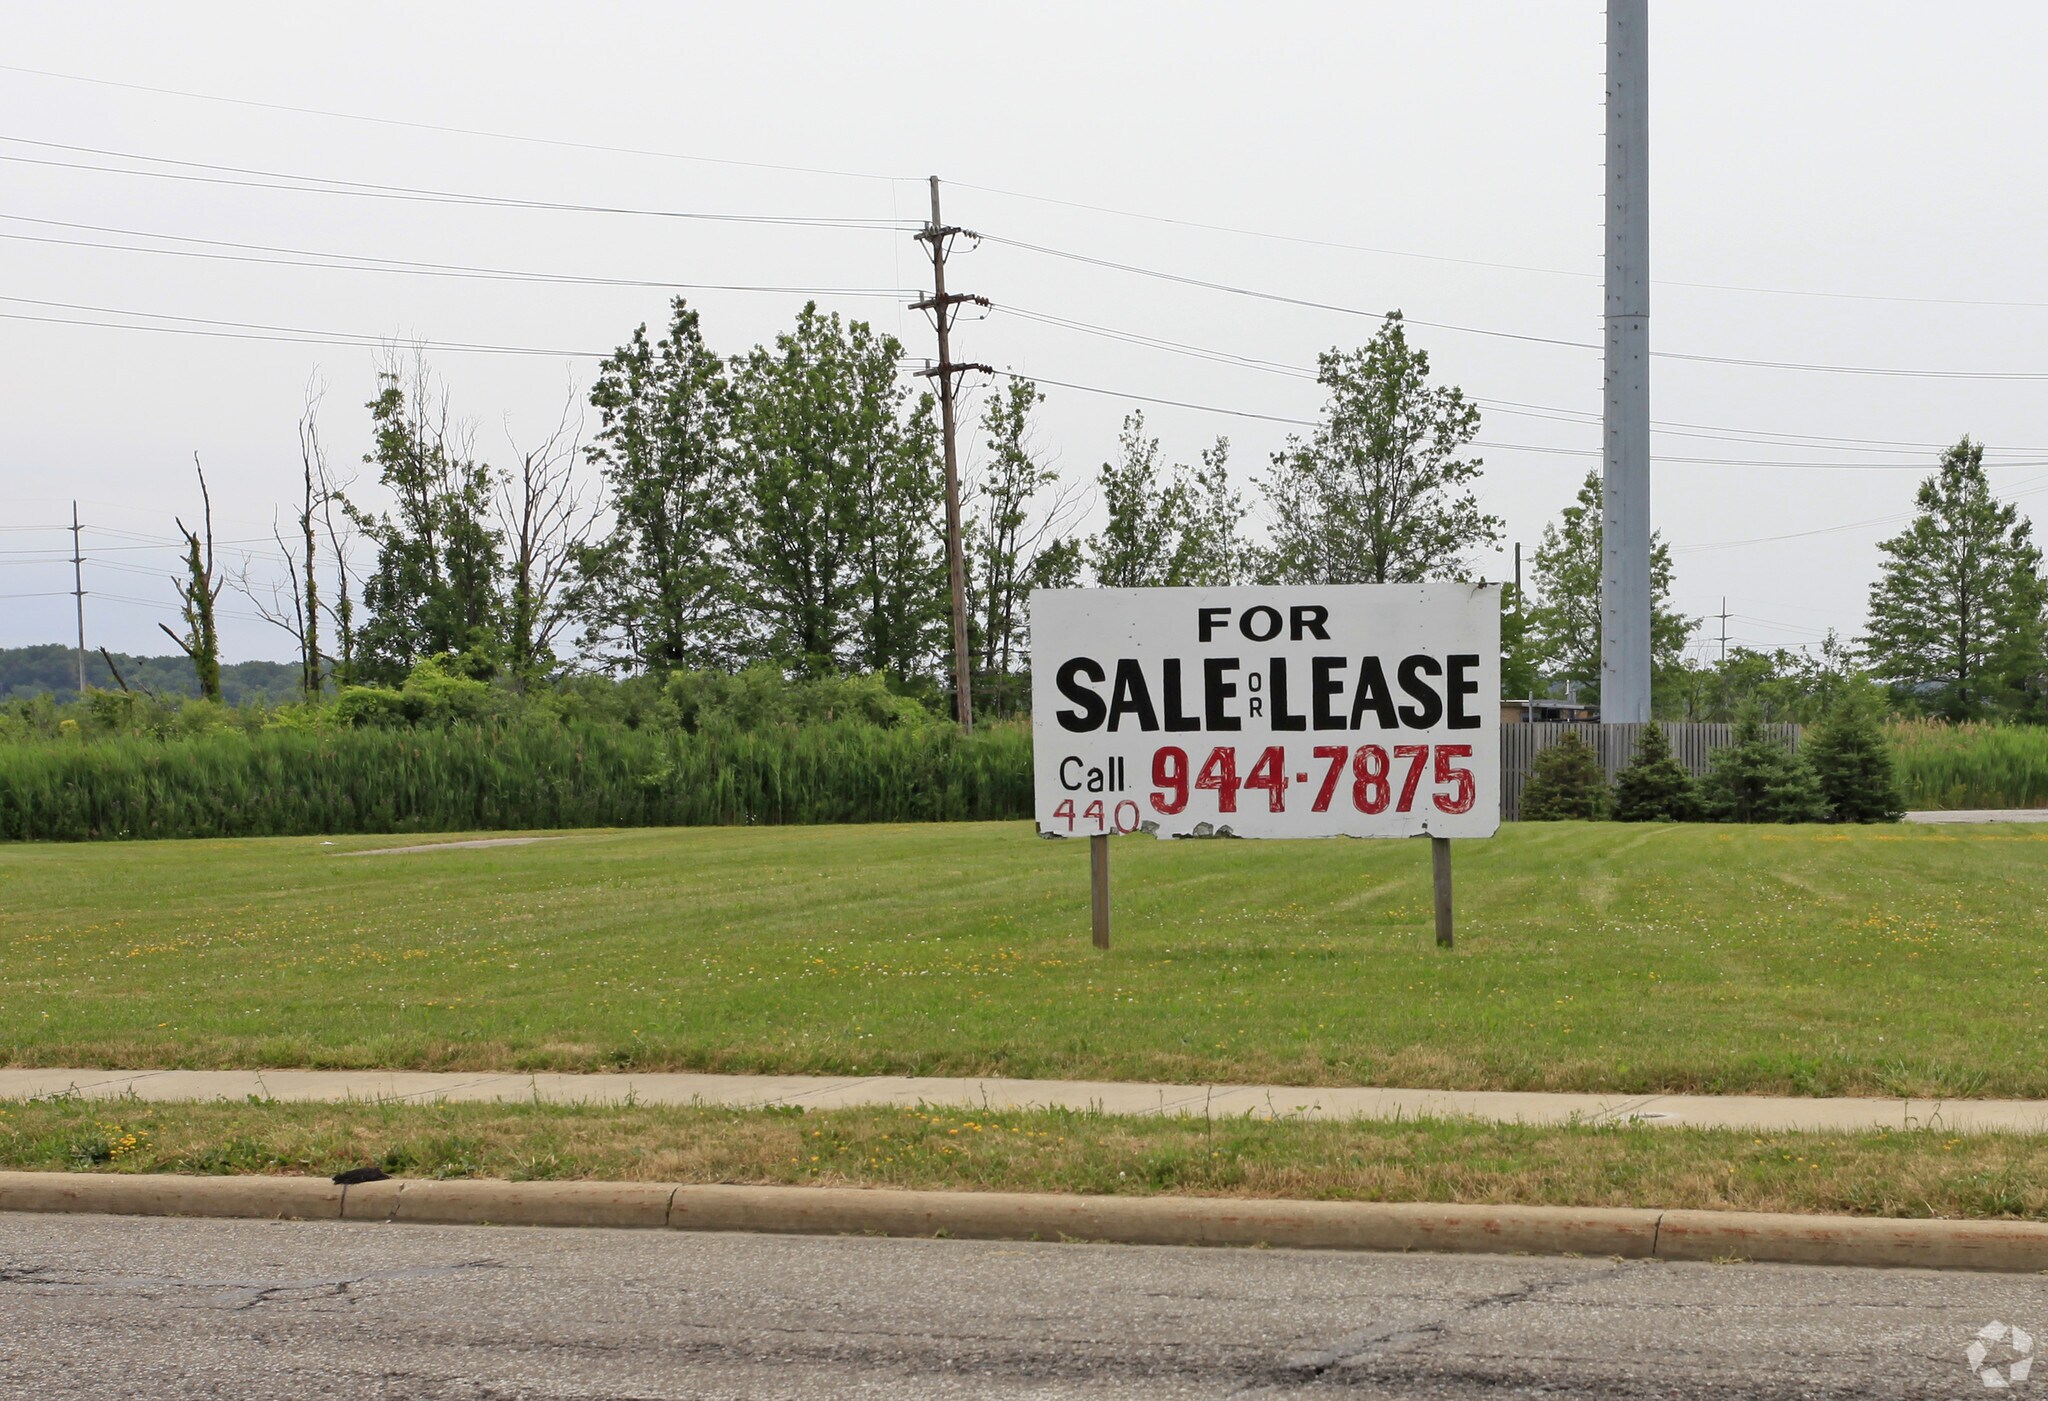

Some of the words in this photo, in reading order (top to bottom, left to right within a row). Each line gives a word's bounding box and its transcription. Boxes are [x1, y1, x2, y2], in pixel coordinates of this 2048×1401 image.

[1198, 604, 1331, 643] FOR
[1055, 656, 1242, 733] SALE
[1247, 671, 1263, 719] OR
[1269, 653, 1482, 731] LEASE
[1059, 755, 1125, 793] Call
[1149, 743, 1477, 816] 944-7875
[1052, 798, 1141, 834] 440
